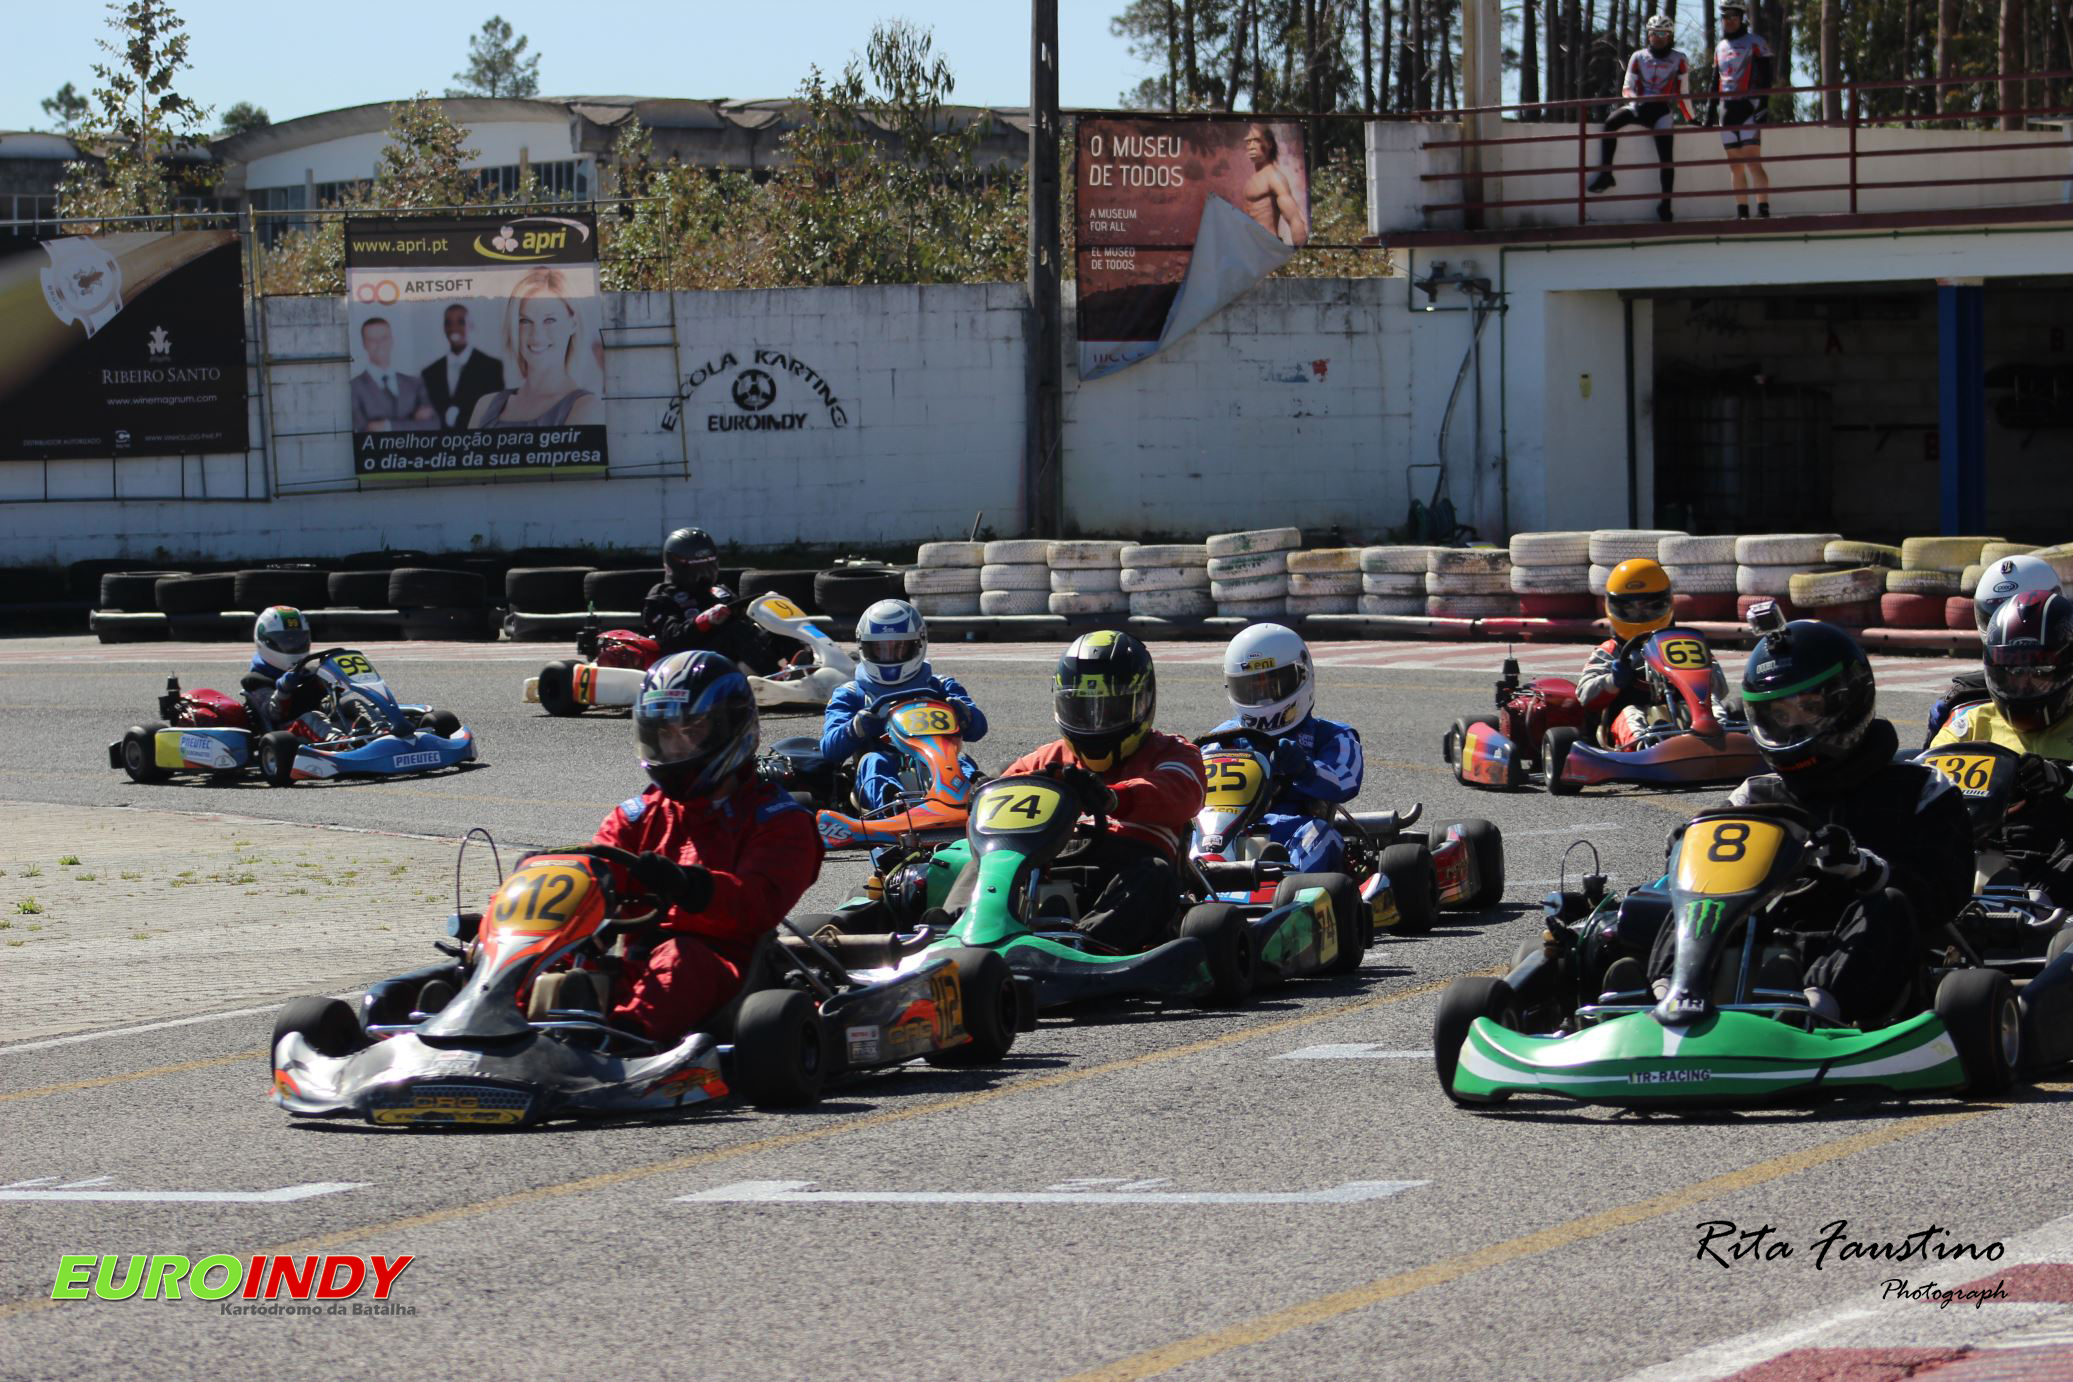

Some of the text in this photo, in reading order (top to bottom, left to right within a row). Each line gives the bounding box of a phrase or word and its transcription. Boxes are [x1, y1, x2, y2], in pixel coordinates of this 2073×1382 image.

[1090, 136, 1182, 158] O MUSEU
[1089, 165, 1184, 187] DE TODOS
[1089, 208, 1137, 219] A MUSEUM
[1090, 221, 1126, 232] FOR ALL
[353, 227, 567, 256] www.apri.pt apri
[1091, 246, 1136, 257] EL MUSEO
[1091, 259, 1136, 270] DE TODOS
[405, 278, 474, 294] ARTSOFT
[102, 367, 221, 385] RIBEIRO SANTO
[754, 350, 848, 429] KARTING
[106, 393, 218, 407] www.winemagnum.com
[708, 413, 808, 432] EUROINDY
[362, 428, 581, 453] A melhor opção para gerir
[364, 449, 601, 470] o dia-a-dia da sua empresa
[773, 599, 795, 616] 9
[1665, 640, 1707, 665] 63
[337, 656, 372, 677] 99
[181, 736, 211, 750] PNEUTEC
[396, 752, 439, 767] PNEUTEC
[986, 794, 1042, 820] 74
[1708, 823, 1751, 862] 8
[1316, 905, 1337, 950] 74
